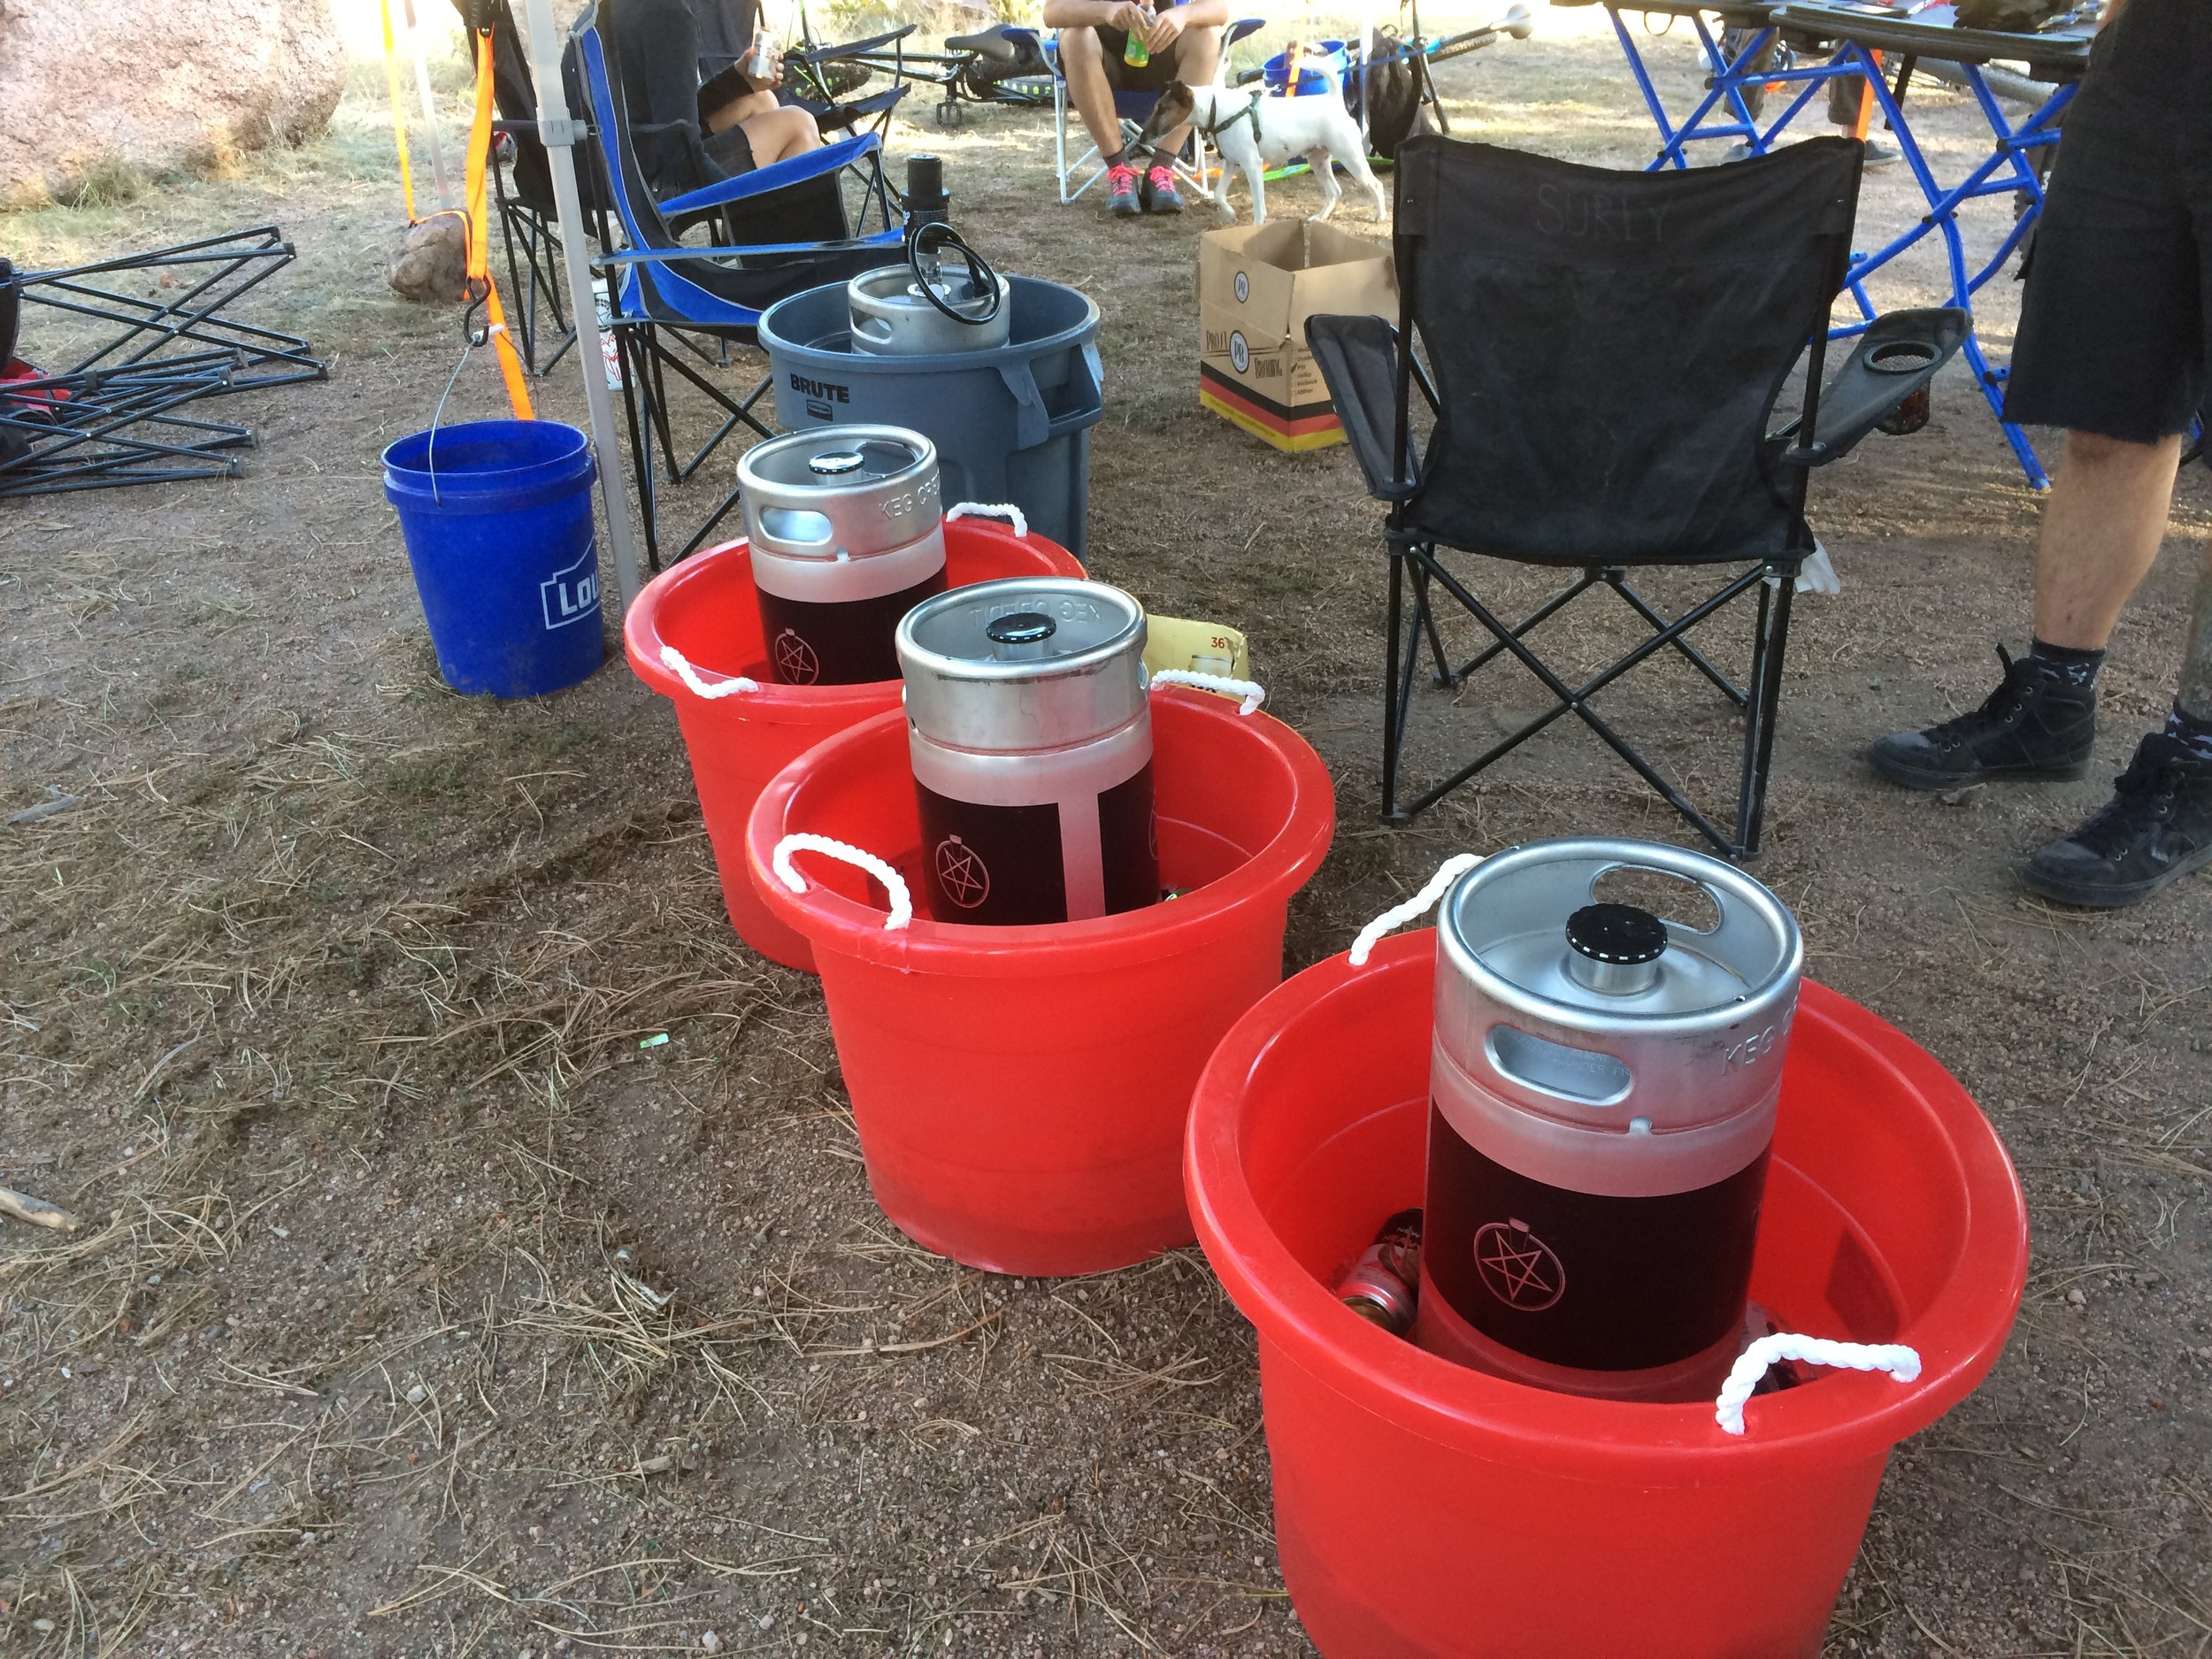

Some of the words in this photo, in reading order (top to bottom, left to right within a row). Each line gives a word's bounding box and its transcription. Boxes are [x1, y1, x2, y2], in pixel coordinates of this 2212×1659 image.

[1536, 183, 1674, 242] SURLY
[1234, 340, 1245, 364] PB
[790, 373, 850, 403] BRUTE
[878, 493, 913, 520] KEG
[1210, 636, 1225, 649] 36
[1722, 1025, 1775, 1077] KEG
